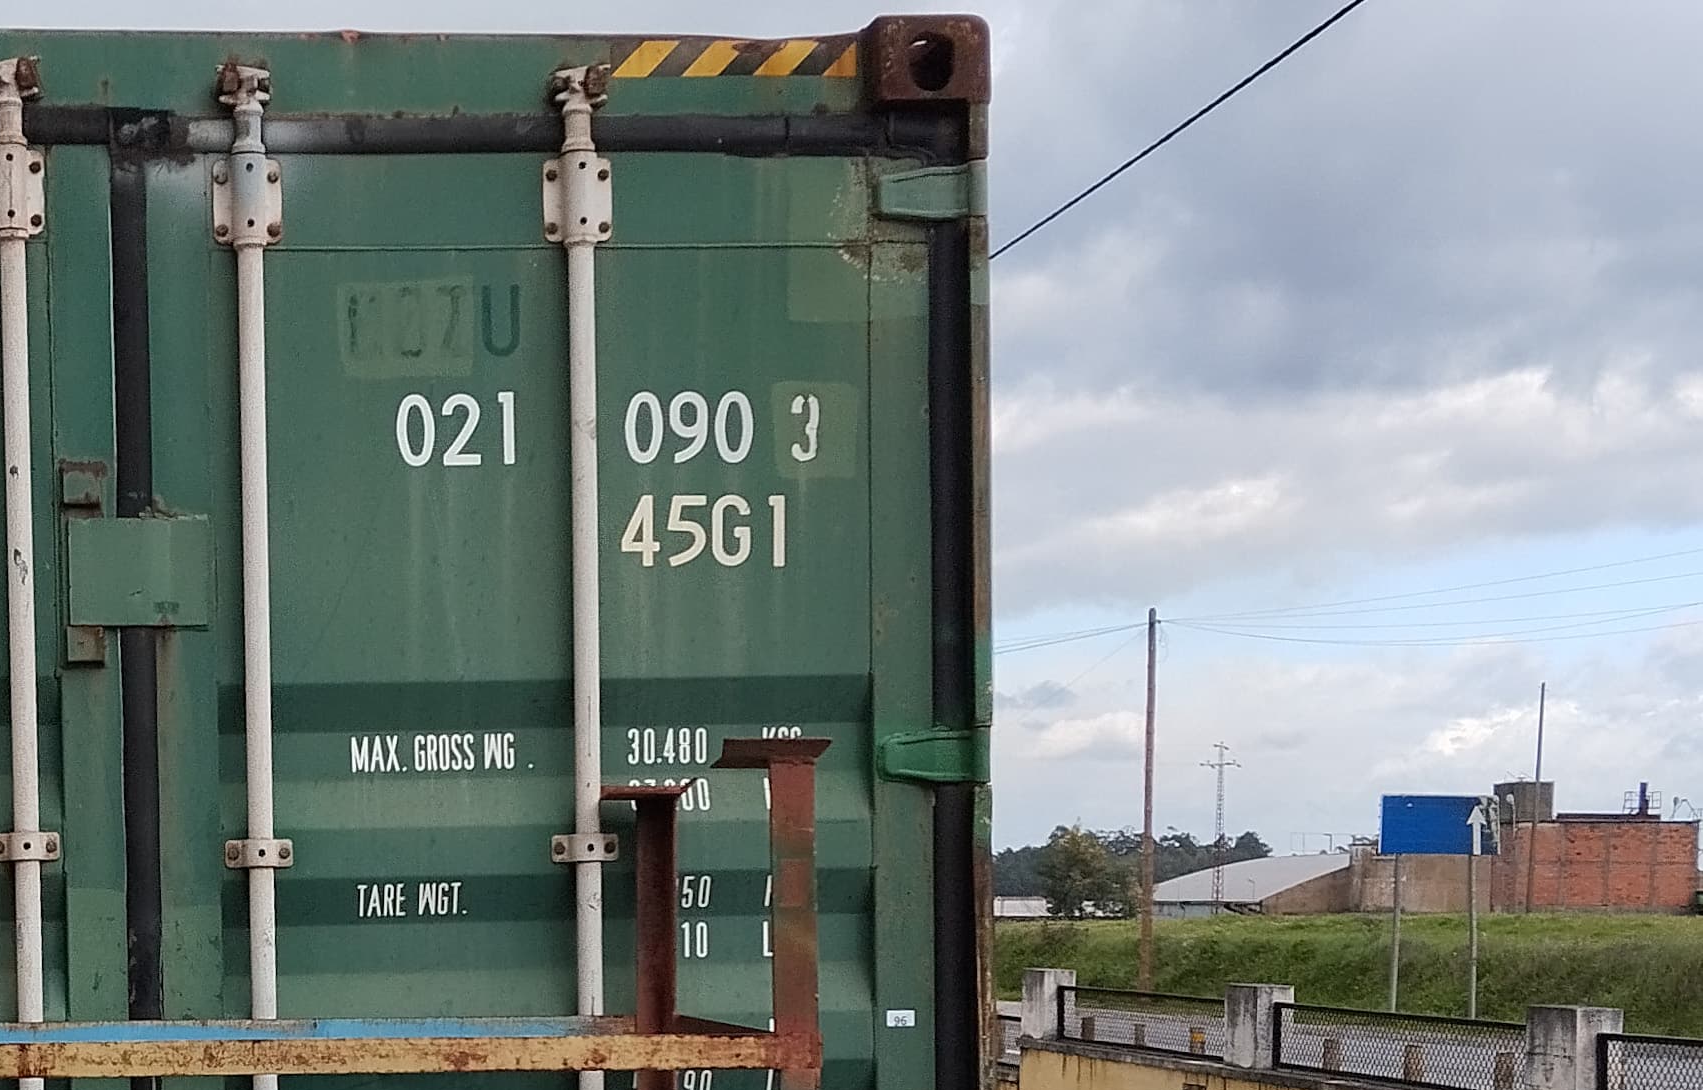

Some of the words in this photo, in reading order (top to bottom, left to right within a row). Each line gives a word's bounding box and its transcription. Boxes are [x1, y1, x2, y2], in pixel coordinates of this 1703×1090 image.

[396, 391, 516, 467] 021
[624, 390, 754, 464] 090
[790, 393, 820, 462] 3
[621, 495, 786, 568] 45G1
[351, 735, 408, 773] MAX.
[414, 733, 475, 772] GROSS
[627, 726, 707, 765] 30.480
[358, 884, 406, 917] TARE
[418, 882, 467, 916] WGT.
